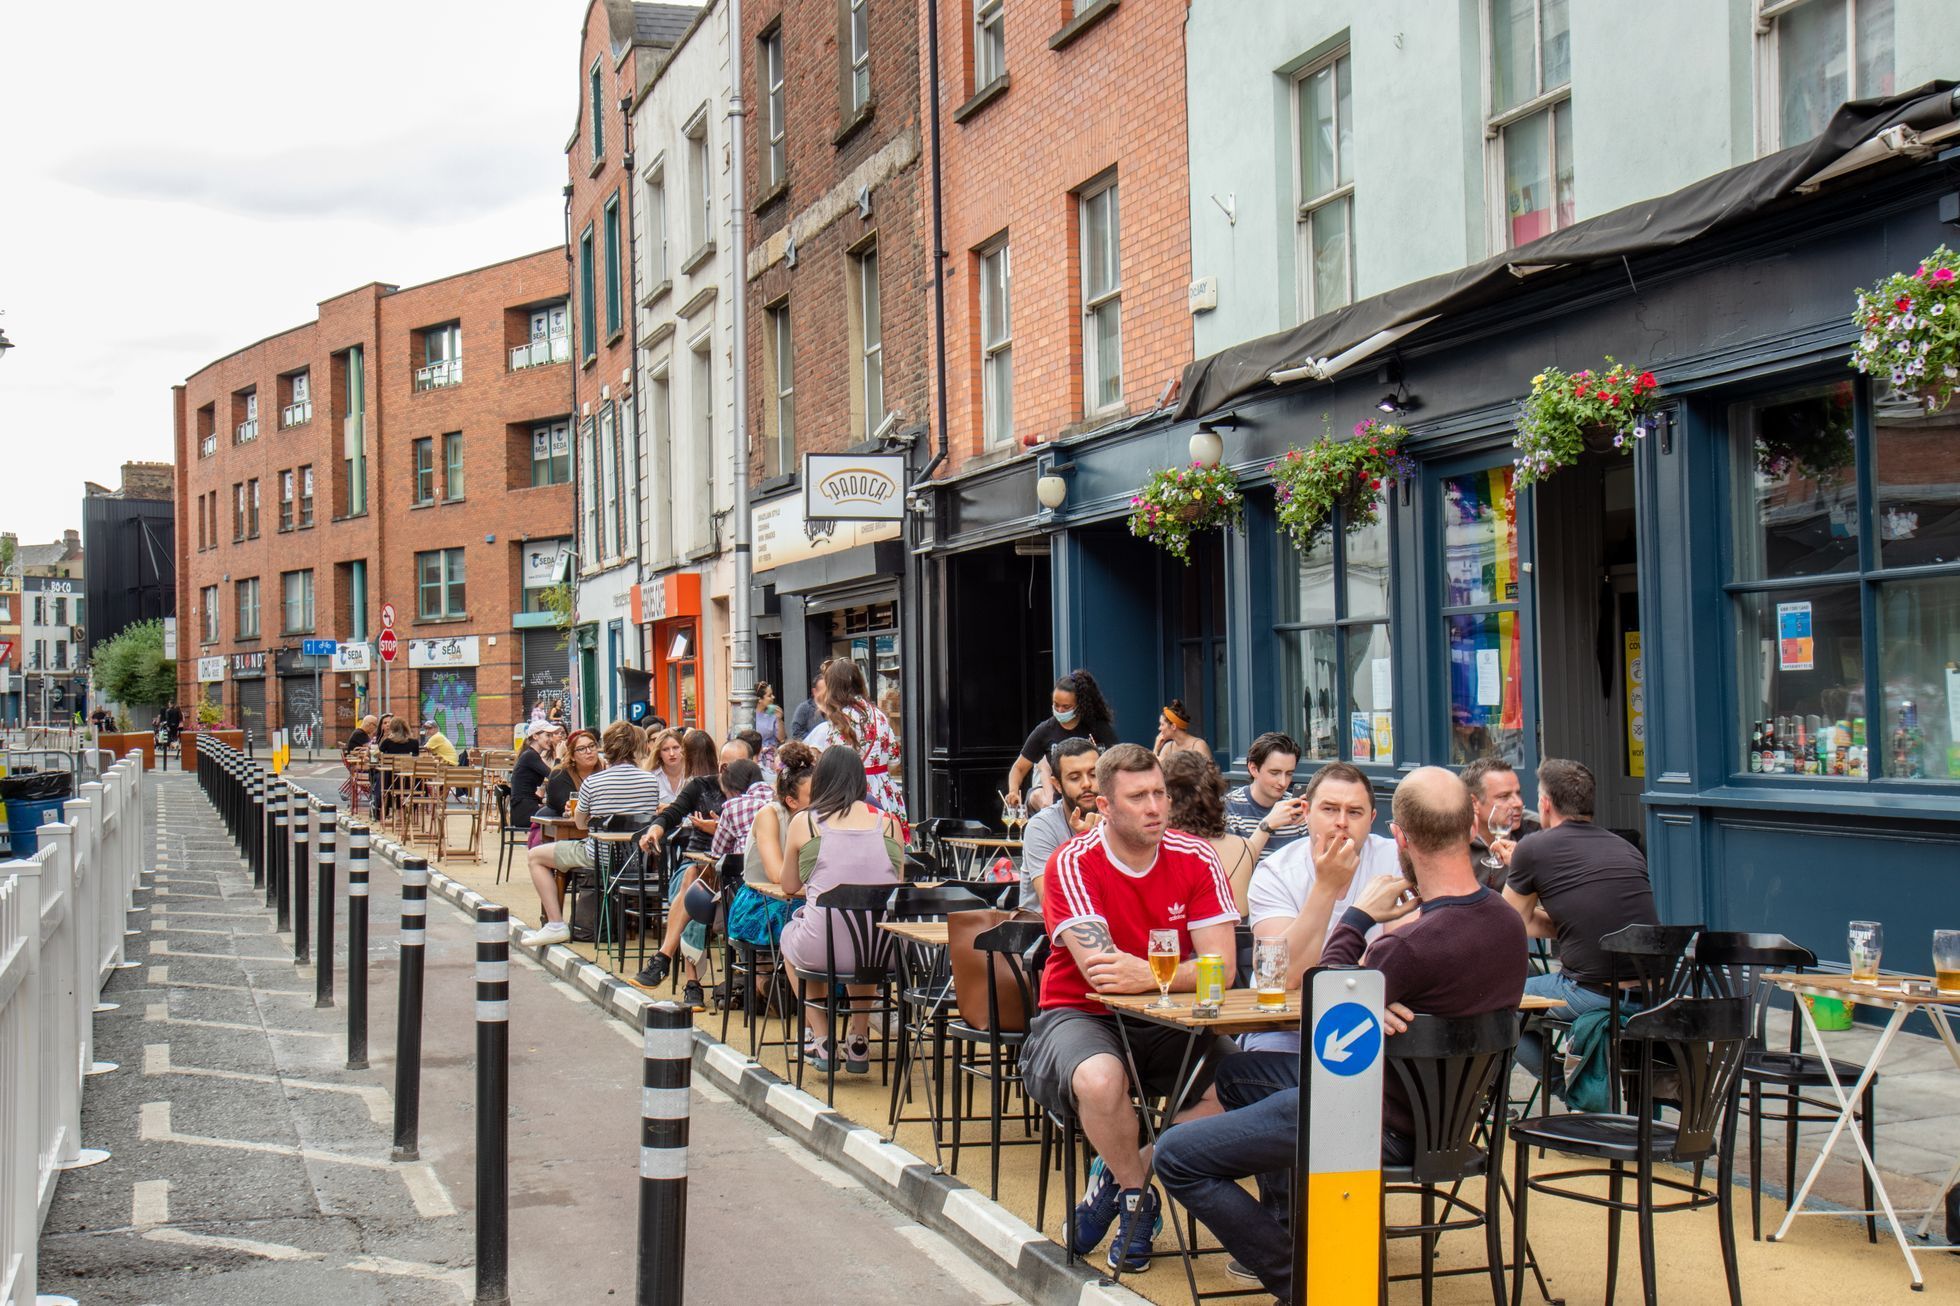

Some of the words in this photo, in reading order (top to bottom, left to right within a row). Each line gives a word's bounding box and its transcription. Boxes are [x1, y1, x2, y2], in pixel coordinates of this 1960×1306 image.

[551, 324, 565, 334] SEDA
[532, 331, 546, 340] SEDA
[535, 445, 548, 453] SEDA
[552, 441, 567, 450] SEDA
[828, 475, 888, 500] PADOCA
[539, 557, 555, 565] SEDA
[380, 640, 397, 652] STOP
[441, 645, 461, 655] SEDA
[347, 649, 363, 660] SEDA
[633, 703, 642, 718] P
[1168, 914, 1186, 922] adidas
